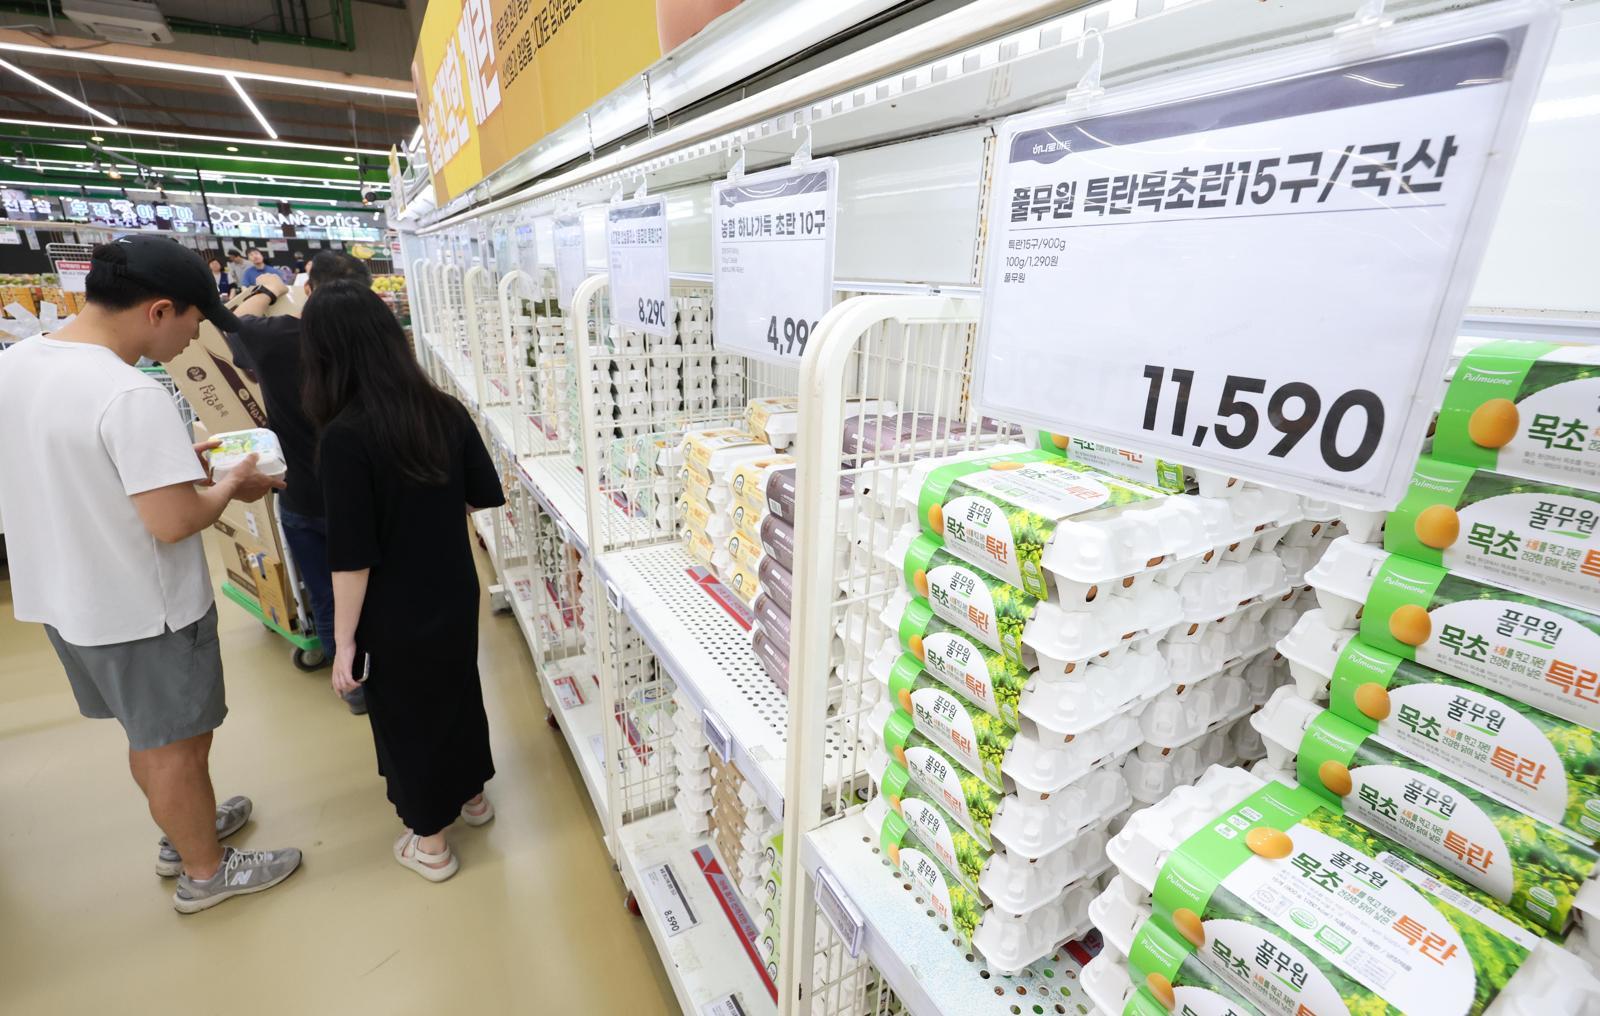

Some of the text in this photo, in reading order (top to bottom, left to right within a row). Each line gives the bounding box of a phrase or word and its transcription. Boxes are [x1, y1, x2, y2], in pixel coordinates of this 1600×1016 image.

[1010, 134, 1458, 222] 풀무원 특란목초란15구/국산
[315, 213, 361, 228] OPTICS
[738, 214, 772, 237] 하나가득
[776, 212, 796, 236] 초란
[800, 210, 826, 235] 10구
[1006, 256, 1059, 269] 100g/1,290원
[1008, 238, 1066, 252] 특란15구/900g
[1004, 273, 1026, 283] 풀무원
[767, 315, 819, 358] 4,99
[1463, 373, 1513, 386] Pulmuone
[1141, 364, 1386, 473] 11,590
[1528, 413, 1589, 452] 목초
[1411, 478, 1454, 493] Pulmuone
[967, 501, 993, 525] 풀무원
[1529, 501, 1600, 534] 풀무원
[947, 516, 966, 543] 목초
[985, 534, 1009, 565] 특란
[1467, 522, 1521, 560] 목초
[949, 571, 976, 595] 풀무원
[931, 582, 989, 633] 목초 특란
[1439, 624, 1490, 663] 목초
[1497, 609, 1563, 645] 풀무원
[946, 639, 971, 664] 풀무원
[927, 649, 987, 699] 목초 특란
[933, 695, 957, 719] 풀무원
[1447, 694, 1506, 733] 풀무원
[915, 703, 971, 756] 목초 특란
[1397, 704, 1442, 743] 목초
[1490, 745, 1546, 791] 특란
[925, 754, 947, 780] 풀무원
[1403, 778, 1458, 818] 풀무원
[920, 806, 940, 833] 풀무원
[1358, 783, 1399, 822] 목초
[1443, 829, 1495, 875] 특란
[918, 858, 937, 885] 풀무원
[1329, 850, 1389, 890] 풀무원
[664, 910, 681, 932] 8,590
[1290, 852, 1344, 894] 목초
[1392, 914, 1458, 966] 특란
[1212, 938, 1251, 983] 목초
[1255, 939, 1308, 989] 풀무원
